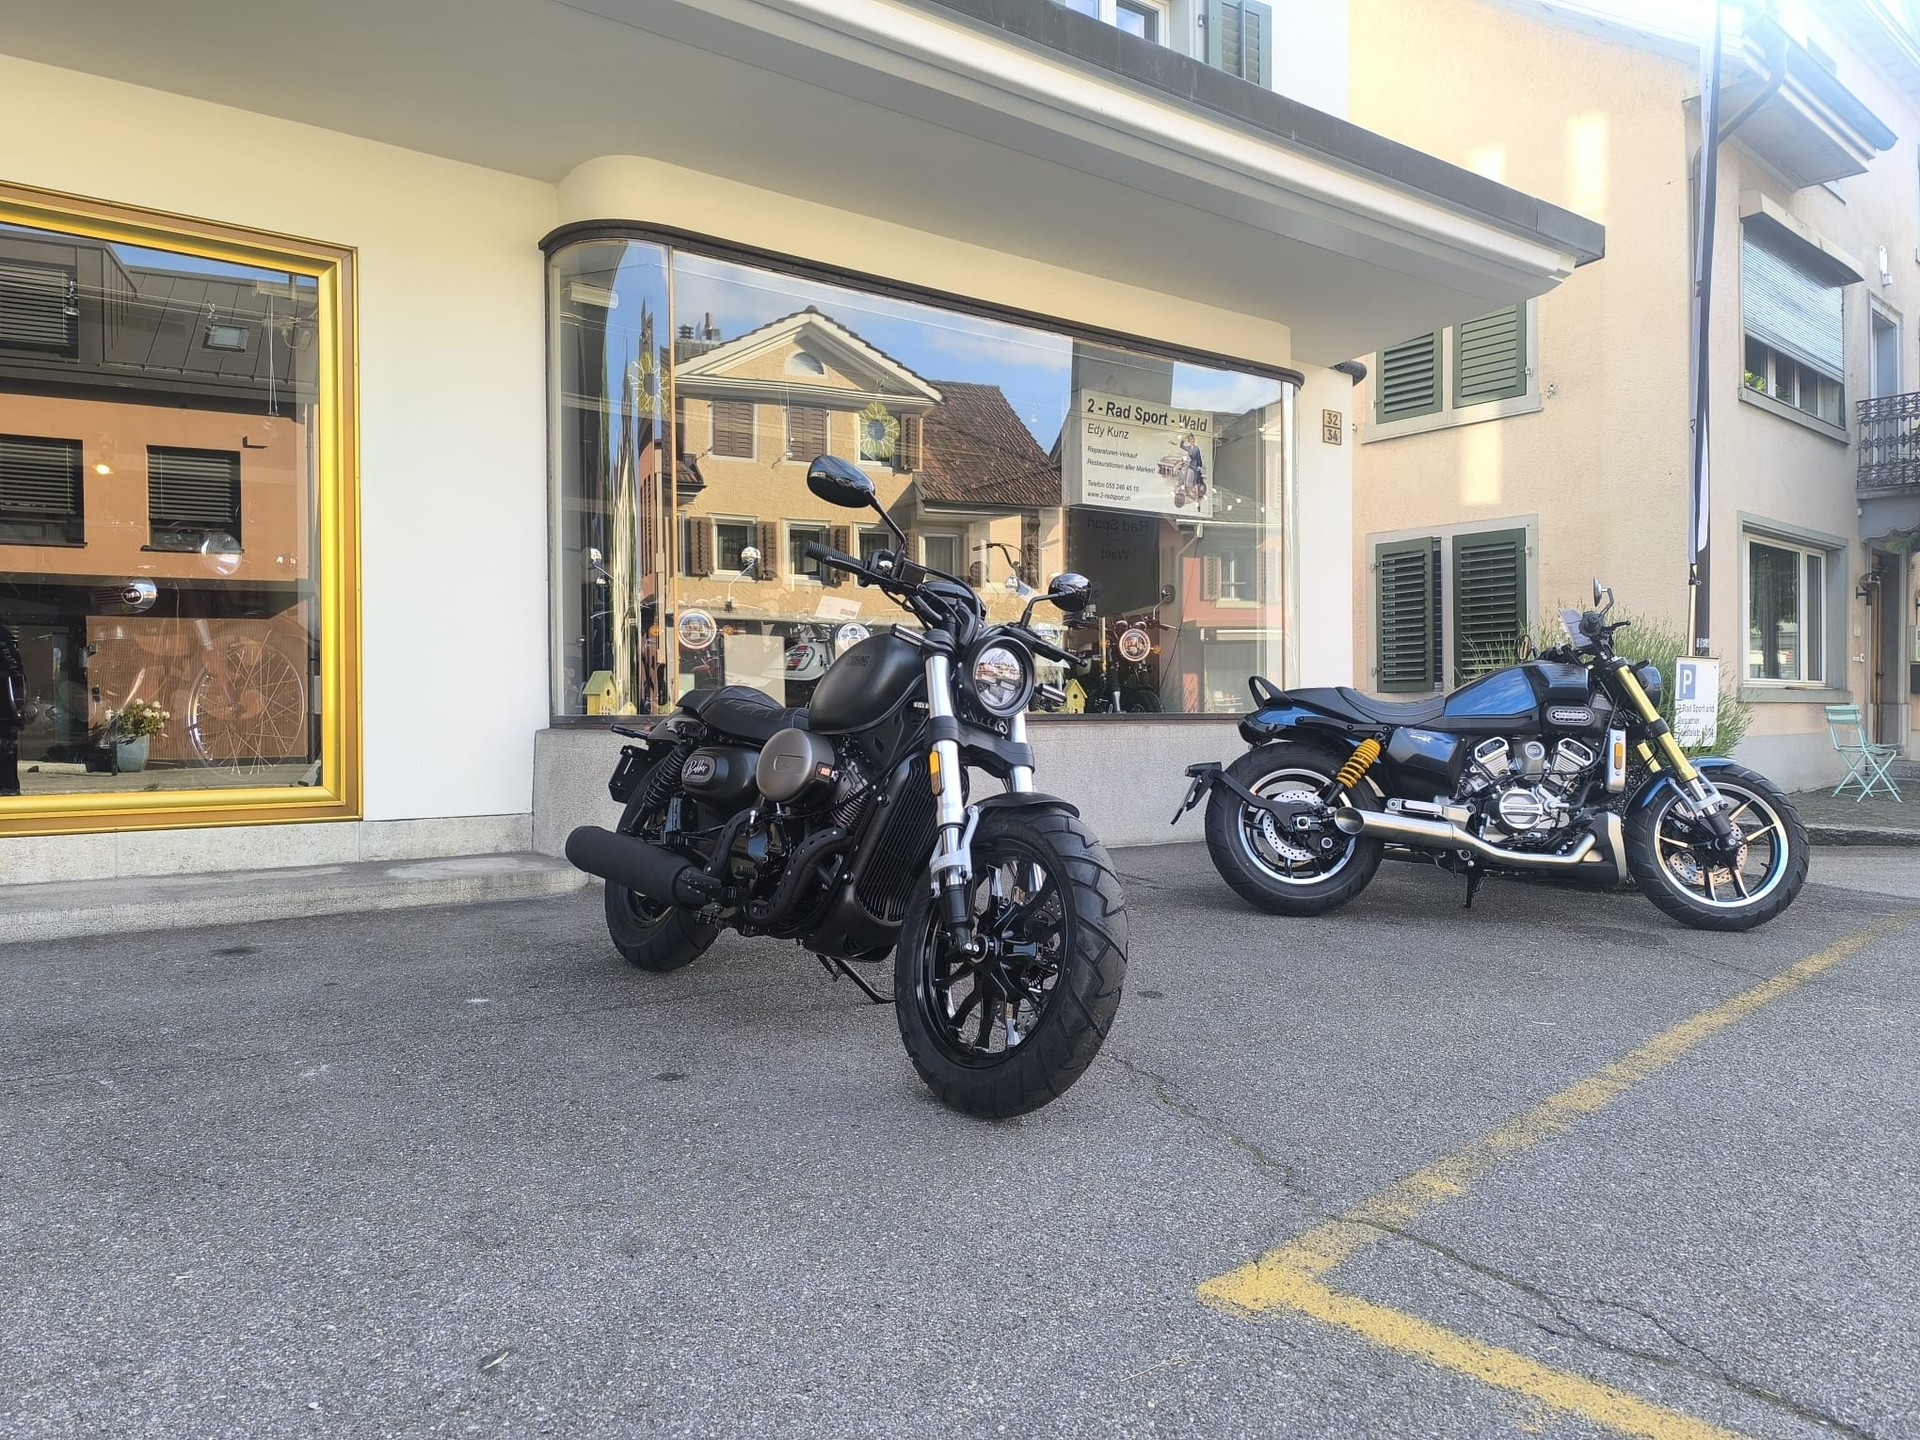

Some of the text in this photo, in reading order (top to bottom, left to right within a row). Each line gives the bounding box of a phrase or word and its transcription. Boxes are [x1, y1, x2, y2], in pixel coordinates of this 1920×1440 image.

[1087, 398, 1095, 413] 2
[1106, 401, 1131, 419] Rad
[1134, 406, 1168, 425] Sport
[1179, 413, 1208, 432] Wald
[1327, 412, 1338, 426] 32
[1087, 423, 1129, 440] Edy Kunz
[1327, 429, 1338, 442] 34
[1087, 479, 1105, 488] Telefon
[1106, 482, 1115, 490] 055
[1682, 669, 1693, 694] P
